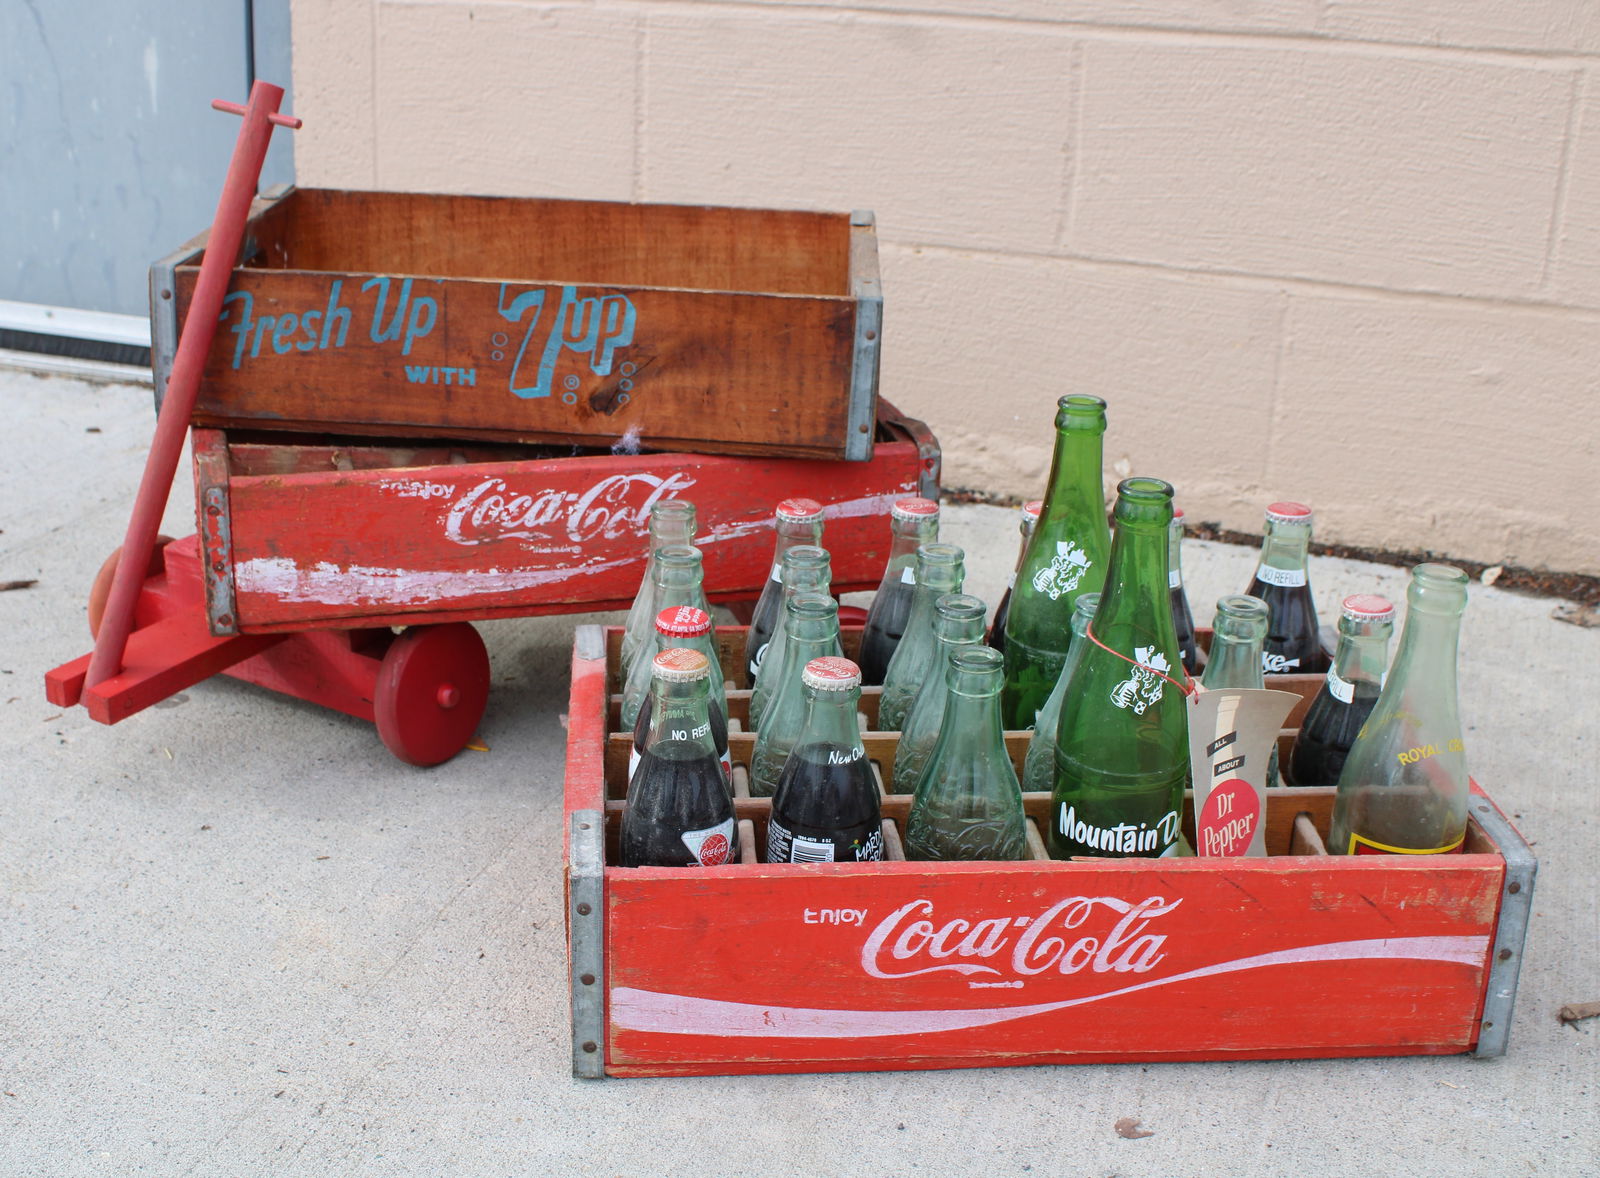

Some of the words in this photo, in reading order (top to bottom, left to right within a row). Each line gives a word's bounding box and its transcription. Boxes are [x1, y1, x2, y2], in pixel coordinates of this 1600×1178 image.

[219, 279, 352, 370] Fresh
[362, 276, 439, 356] Up
[404, 365, 476, 386] WITH
[437, 472, 698, 546] Coca-Col
[672, 729, 688, 741] NO
[1213, 737, 1227, 750] ALL
[827, 749, 852, 765] New
[1217, 759, 1240, 773] ABOUT
[1397, 743, 1443, 766] ROYAL
[1215, 791, 1235, 820] Dr
[1059, 801, 1158, 853] Mountain
[1203, 812, 1254, 857] Pepper
[804, 907, 868, 929] Enjoy
[861, 895, 1184, 980] Coca-Cola
